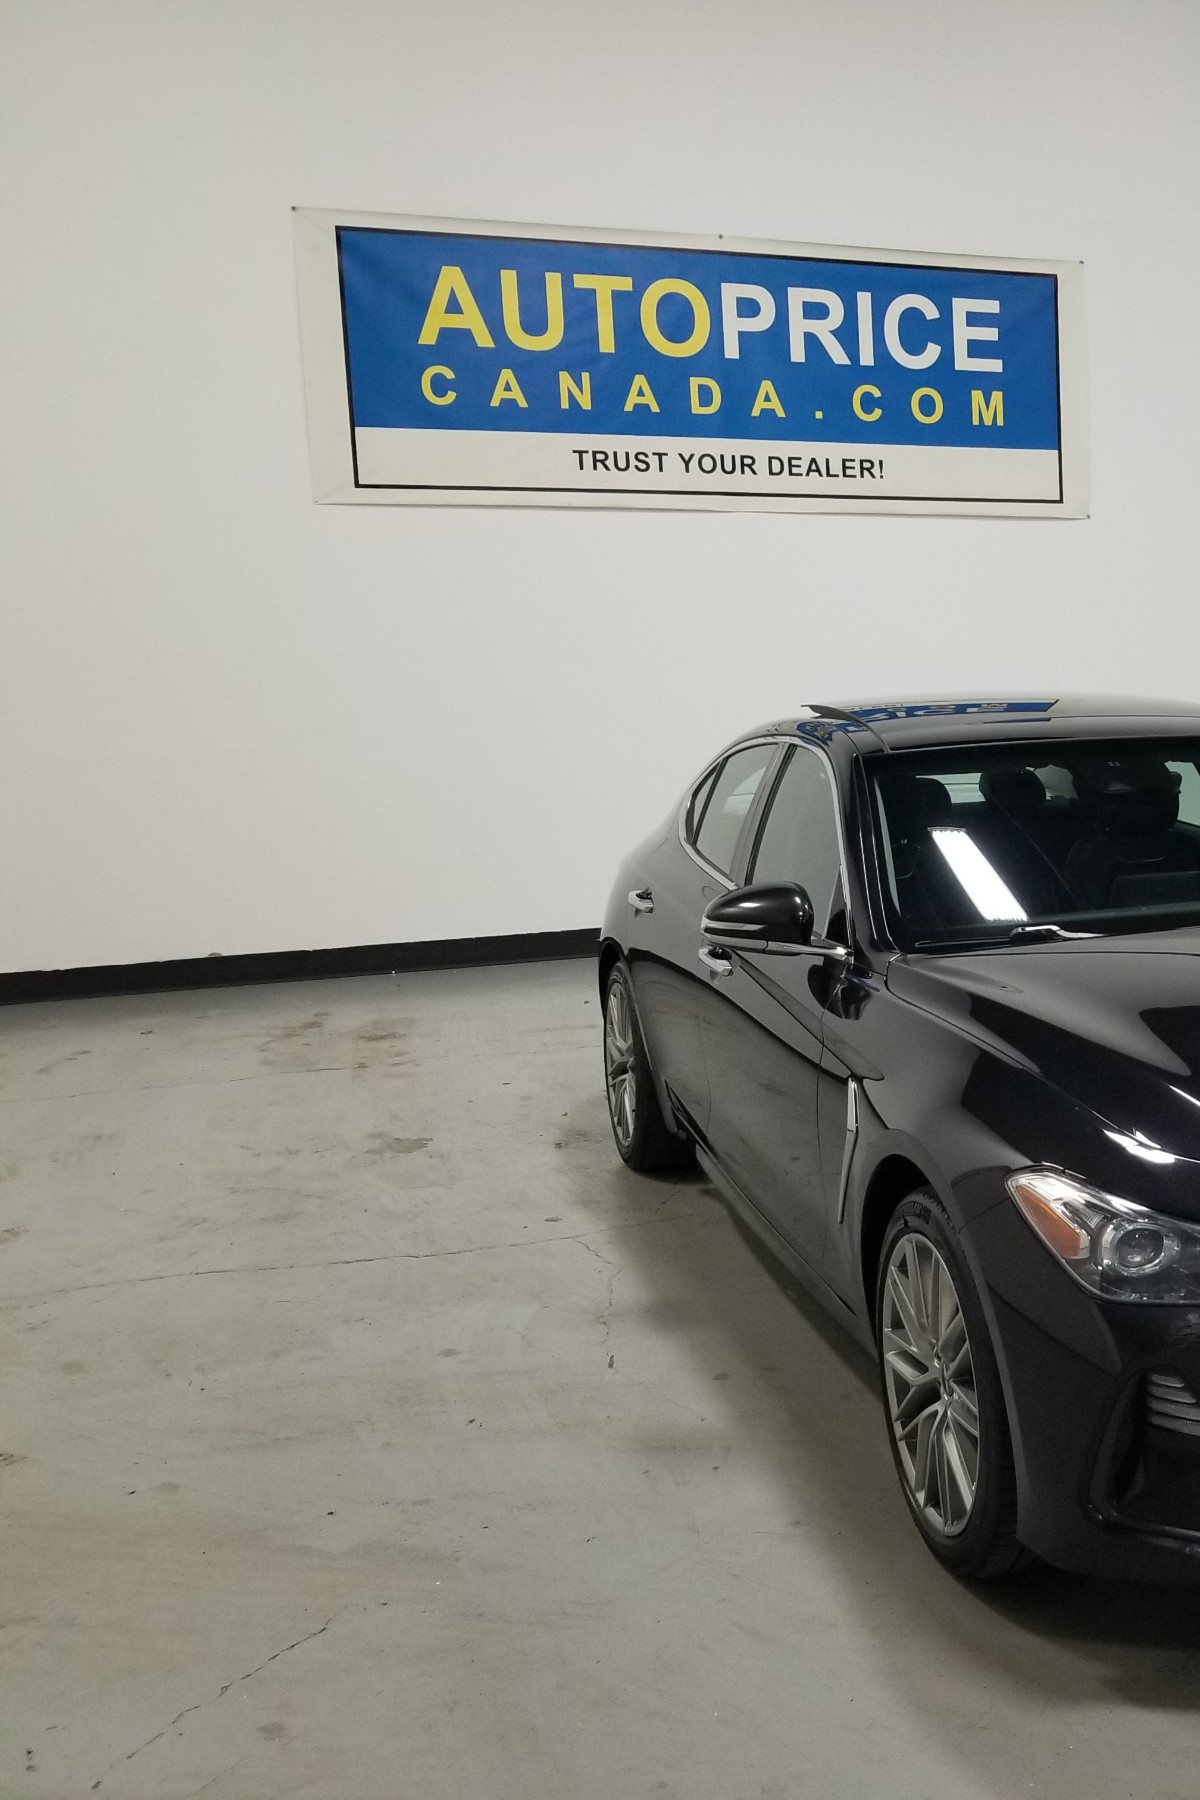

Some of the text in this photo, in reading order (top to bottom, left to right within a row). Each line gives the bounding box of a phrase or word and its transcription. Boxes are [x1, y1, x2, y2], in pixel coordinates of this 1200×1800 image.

[416, 263, 1004, 374] AUTOPRICE
[420, 364, 1006, 427] CANADA.COM
[571, 448, 885, 480] TRUST YOUR DEALER!
